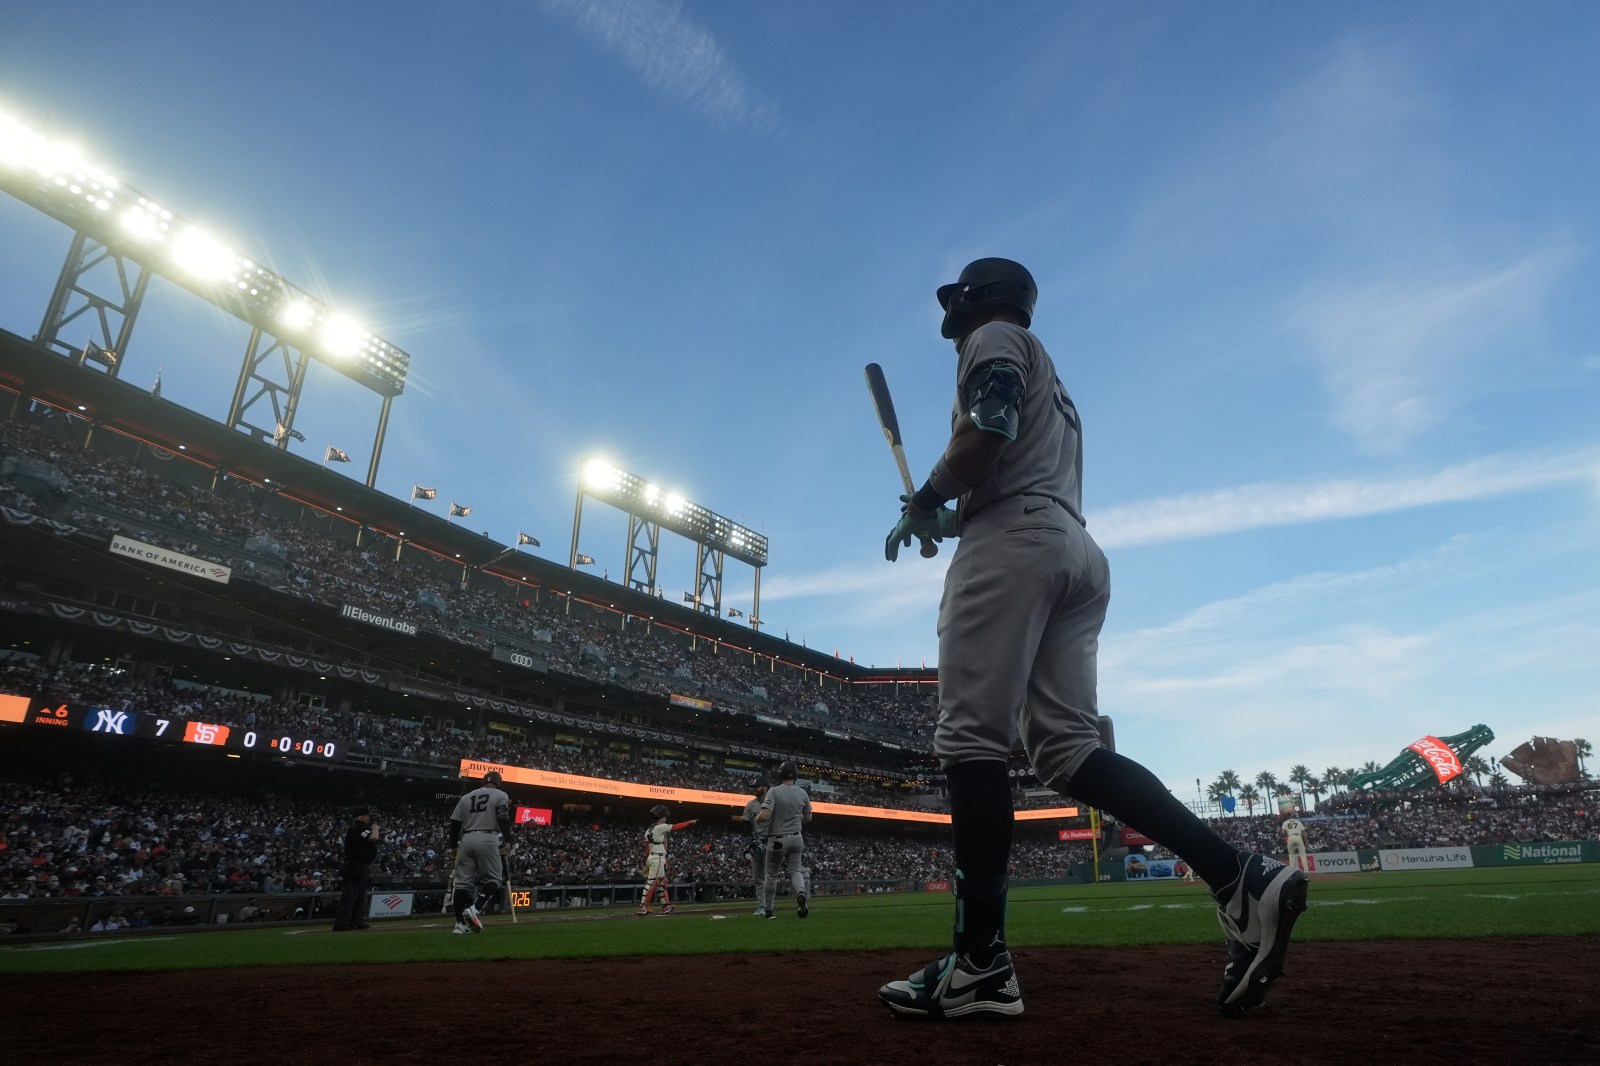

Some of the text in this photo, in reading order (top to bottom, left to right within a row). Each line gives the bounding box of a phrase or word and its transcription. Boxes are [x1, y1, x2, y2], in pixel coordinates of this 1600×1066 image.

[112, 542, 207, 574] BANK OF AMERICA
[55, 704, 68, 718] 6
[35, 716, 68, 726] INNING
[92, 709, 128, 735] NY
[155, 719, 170, 737] 7
[243, 731, 257, 748] 0
[271, 739, 278, 748] B
[279, 736, 292, 752] 0
[302, 739, 314, 755] 0
[323, 742, 335, 758] 0
[469, 763, 504, 774] nuveen
[540, 774, 557, 783] Invest
[649, 787, 675, 795] nuveen
[469, 794, 490, 813] 12
[1287, 822, 1298, 830] 67
[1522, 844, 1582, 858] National
[1317, 858, 1356, 867] TOYOTA
[1401, 853, 1467, 863] Hanwha Life
